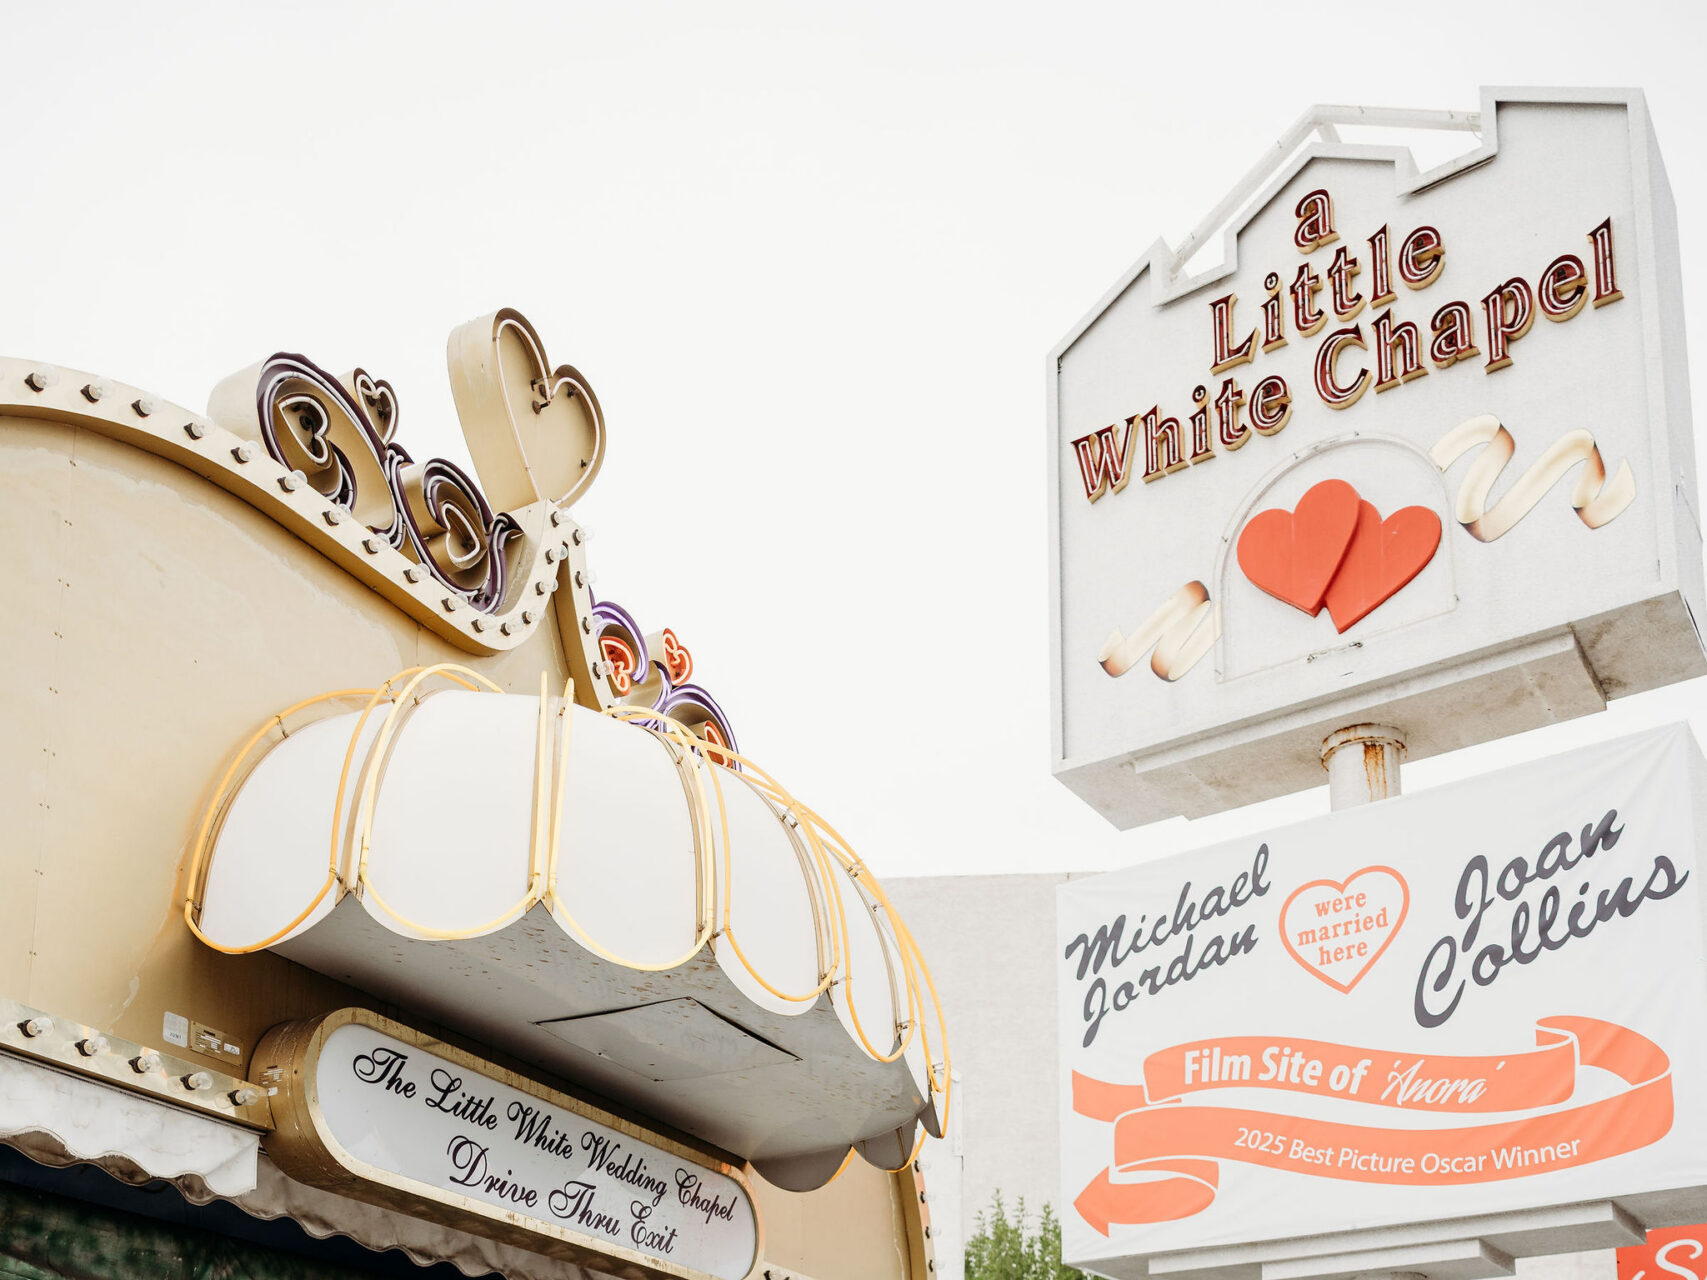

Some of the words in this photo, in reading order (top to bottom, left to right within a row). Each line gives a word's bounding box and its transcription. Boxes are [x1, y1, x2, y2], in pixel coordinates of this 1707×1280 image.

[1294, 189, 1340, 253] a
[1071, 375, 1292, 504] White
[1314, 217, 1624, 409] Chapel
[1210, 224, 1445, 376] Little
[1065, 843, 1271, 981] Michael
[1297, 908, 1389, 946] married
[1315, 890, 1367, 918] were
[1455, 809, 1625, 952] Joan
[1083, 924, 1259, 1048] Jordan
[1319, 939, 1368, 966] here
[1414, 855, 1689, 1028] Collins
[1184, 1047, 1251, 1085] Film
[1258, 1046, 1320, 1087] Site
[1328, 1058, 1372, 1095] of
[353, 1047, 416, 1099] The
[425, 1068, 498, 1131] Little
[507, 1101, 574, 1160] White
[580, 1131, 667, 1204] Wedding
[675, 1168, 739, 1223] Chapel
[446, 1135, 538, 1208] Drive
[549, 1180, 620, 1236] Thru
[630, 1200, 679, 1254] Exit
[1234, 1127, 1285, 1154] 2025
[1292, 1139, 1332, 1166] Best
[1338, 1146, 1415, 1174] Picture
[1421, 1151, 1487, 1173] Oscar
[1492, 1139, 1581, 1170] Winner
